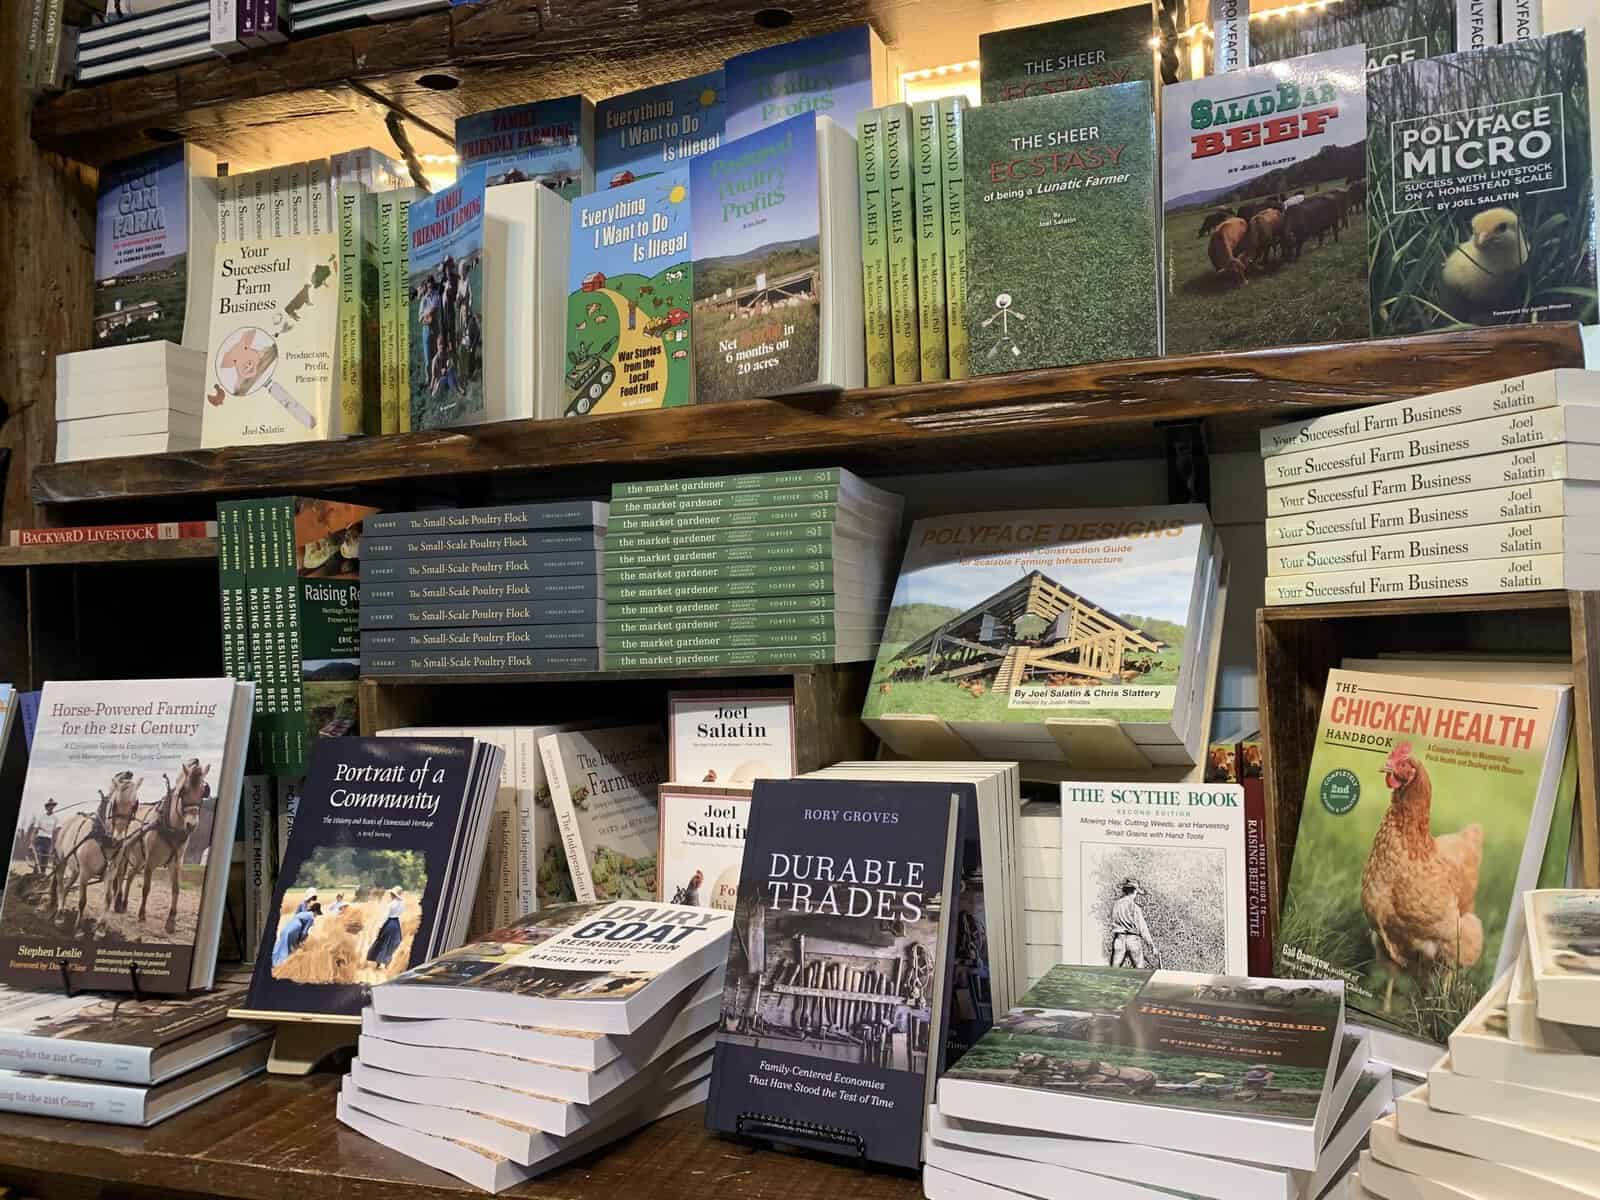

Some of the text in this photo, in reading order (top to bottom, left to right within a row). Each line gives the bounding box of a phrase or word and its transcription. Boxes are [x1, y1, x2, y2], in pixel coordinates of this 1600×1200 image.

[1024, 50, 1106, 76] THE SHEER
[1012, 127, 1099, 150] THE SHEER
[1192, 107, 1339, 160] BEEF
[1403, 107, 1550, 149] POLYFACE
[990, 144, 1128, 183] ECSTASY
[1404, 130, 1551, 179] MICRO
[1405, 162, 1552, 192] SUCCESS WITH LIVESTOCK
[1405, 192, 1421, 201] ON
[1439, 179, 1510, 195] HOMESTEAD
[1515, 171, 1552, 184] SCALE
[984, 193, 995, 202] of
[997, 188, 1024, 200] being
[1037, 178, 1081, 195] Lunatic
[1085, 174, 1130, 187] Farmer
[119, 187, 158, 215] CAN
[723, 189, 785, 223] Profits
[1438, 192, 1519, 210] BY JOEL SALATIN
[113, 208, 166, 239] FARM
[581, 197, 645, 229] Everything
[865, 188, 879, 247] LABELS
[412, 214, 450, 248] FRIENDLY
[452, 201, 481, 233] FARMING
[595, 213, 668, 249] I Want to Do
[240, 247, 269, 259] Your
[344, 196, 355, 303] BEYOND LABELS
[633, 233, 687, 262] Is Illegal
[222, 258, 291, 277] Successful
[236, 278, 271, 295] Farm
[219, 297, 277, 314] Business
[719, 325, 794, 353] Net in
[618, 346, 661, 362] War Stories
[726, 339, 789, 364] 6 months on
[624, 359, 655, 374] from the
[738, 357, 779, 375] 20 acres
[629, 372, 648, 384] Local
[620, 381, 658, 397] Food Front
[1509, 416, 1534, 429] Joel
[1502, 430, 1543, 445] Salatin
[1277, 438, 1470, 478] Your Successful Farm Business
[627, 480, 724, 494] the market gardener
[22, 525, 154, 544] BACKYARD LIVESTOCK
[920, 519, 1185, 546] POLYFACE DESIGNS
[422, 560, 529, 574] Small-Scale Poultry Flock
[305, 584, 346, 605] Raising
[288, 586, 302, 711] RAISING RESILIENT BEES
[1014, 689, 1161, 699] By Joel Salatin & Chris Slattery
[1336, 682, 1357, 693] THE
[52, 701, 217, 717] Horse-Powered Farming
[714, 707, 748, 719] Joel
[62, 721, 199, 736] for the 21st Century
[697, 724, 766, 738] Salatin
[1331, 696, 1535, 750] CHICKEN HEALTH
[1326, 729, 1393, 748] HANDBOOK
[577, 754, 597, 769] The
[334, 757, 445, 790] Portrait of a
[587, 769, 659, 796] Farmstead
[1069, 787, 1239, 808] THE SCYTHE BOOK
[1331, 784, 1349, 794] 2nd
[330, 789, 440, 816] Community
[704, 805, 735, 818] Joel
[804, 809, 899, 824] RORY GROVES
[1080, 817, 1106, 827] Mowing
[1124, 819, 1149, 828] Cutting
[1193, 822, 1230, 830] Harvesting
[1105, 829, 1125, 837] Small
[1126, 830, 1148, 838] Grains
[253, 848, 262, 887] MICRO
[768, 853, 924, 889] DURABLE
[1248, 820, 1259, 937] RAISING BEEF CATTLE
[768, 882, 922, 922] TRADES
[601, 905, 724, 926] DAIRY
[571, 921, 708, 945] GOAT
[18, 945, 84, 958] Stephen Leslie
[556, 938, 681, 952] REPRODUCTION
[1283, 944, 1296, 956] Gail
[528, 953, 625, 965] RACHEL PAYNE
[759, 1060, 886, 1090] Family-Centered Economies
[748, 1074, 895, 1109] That Have Stood the Test of Time
